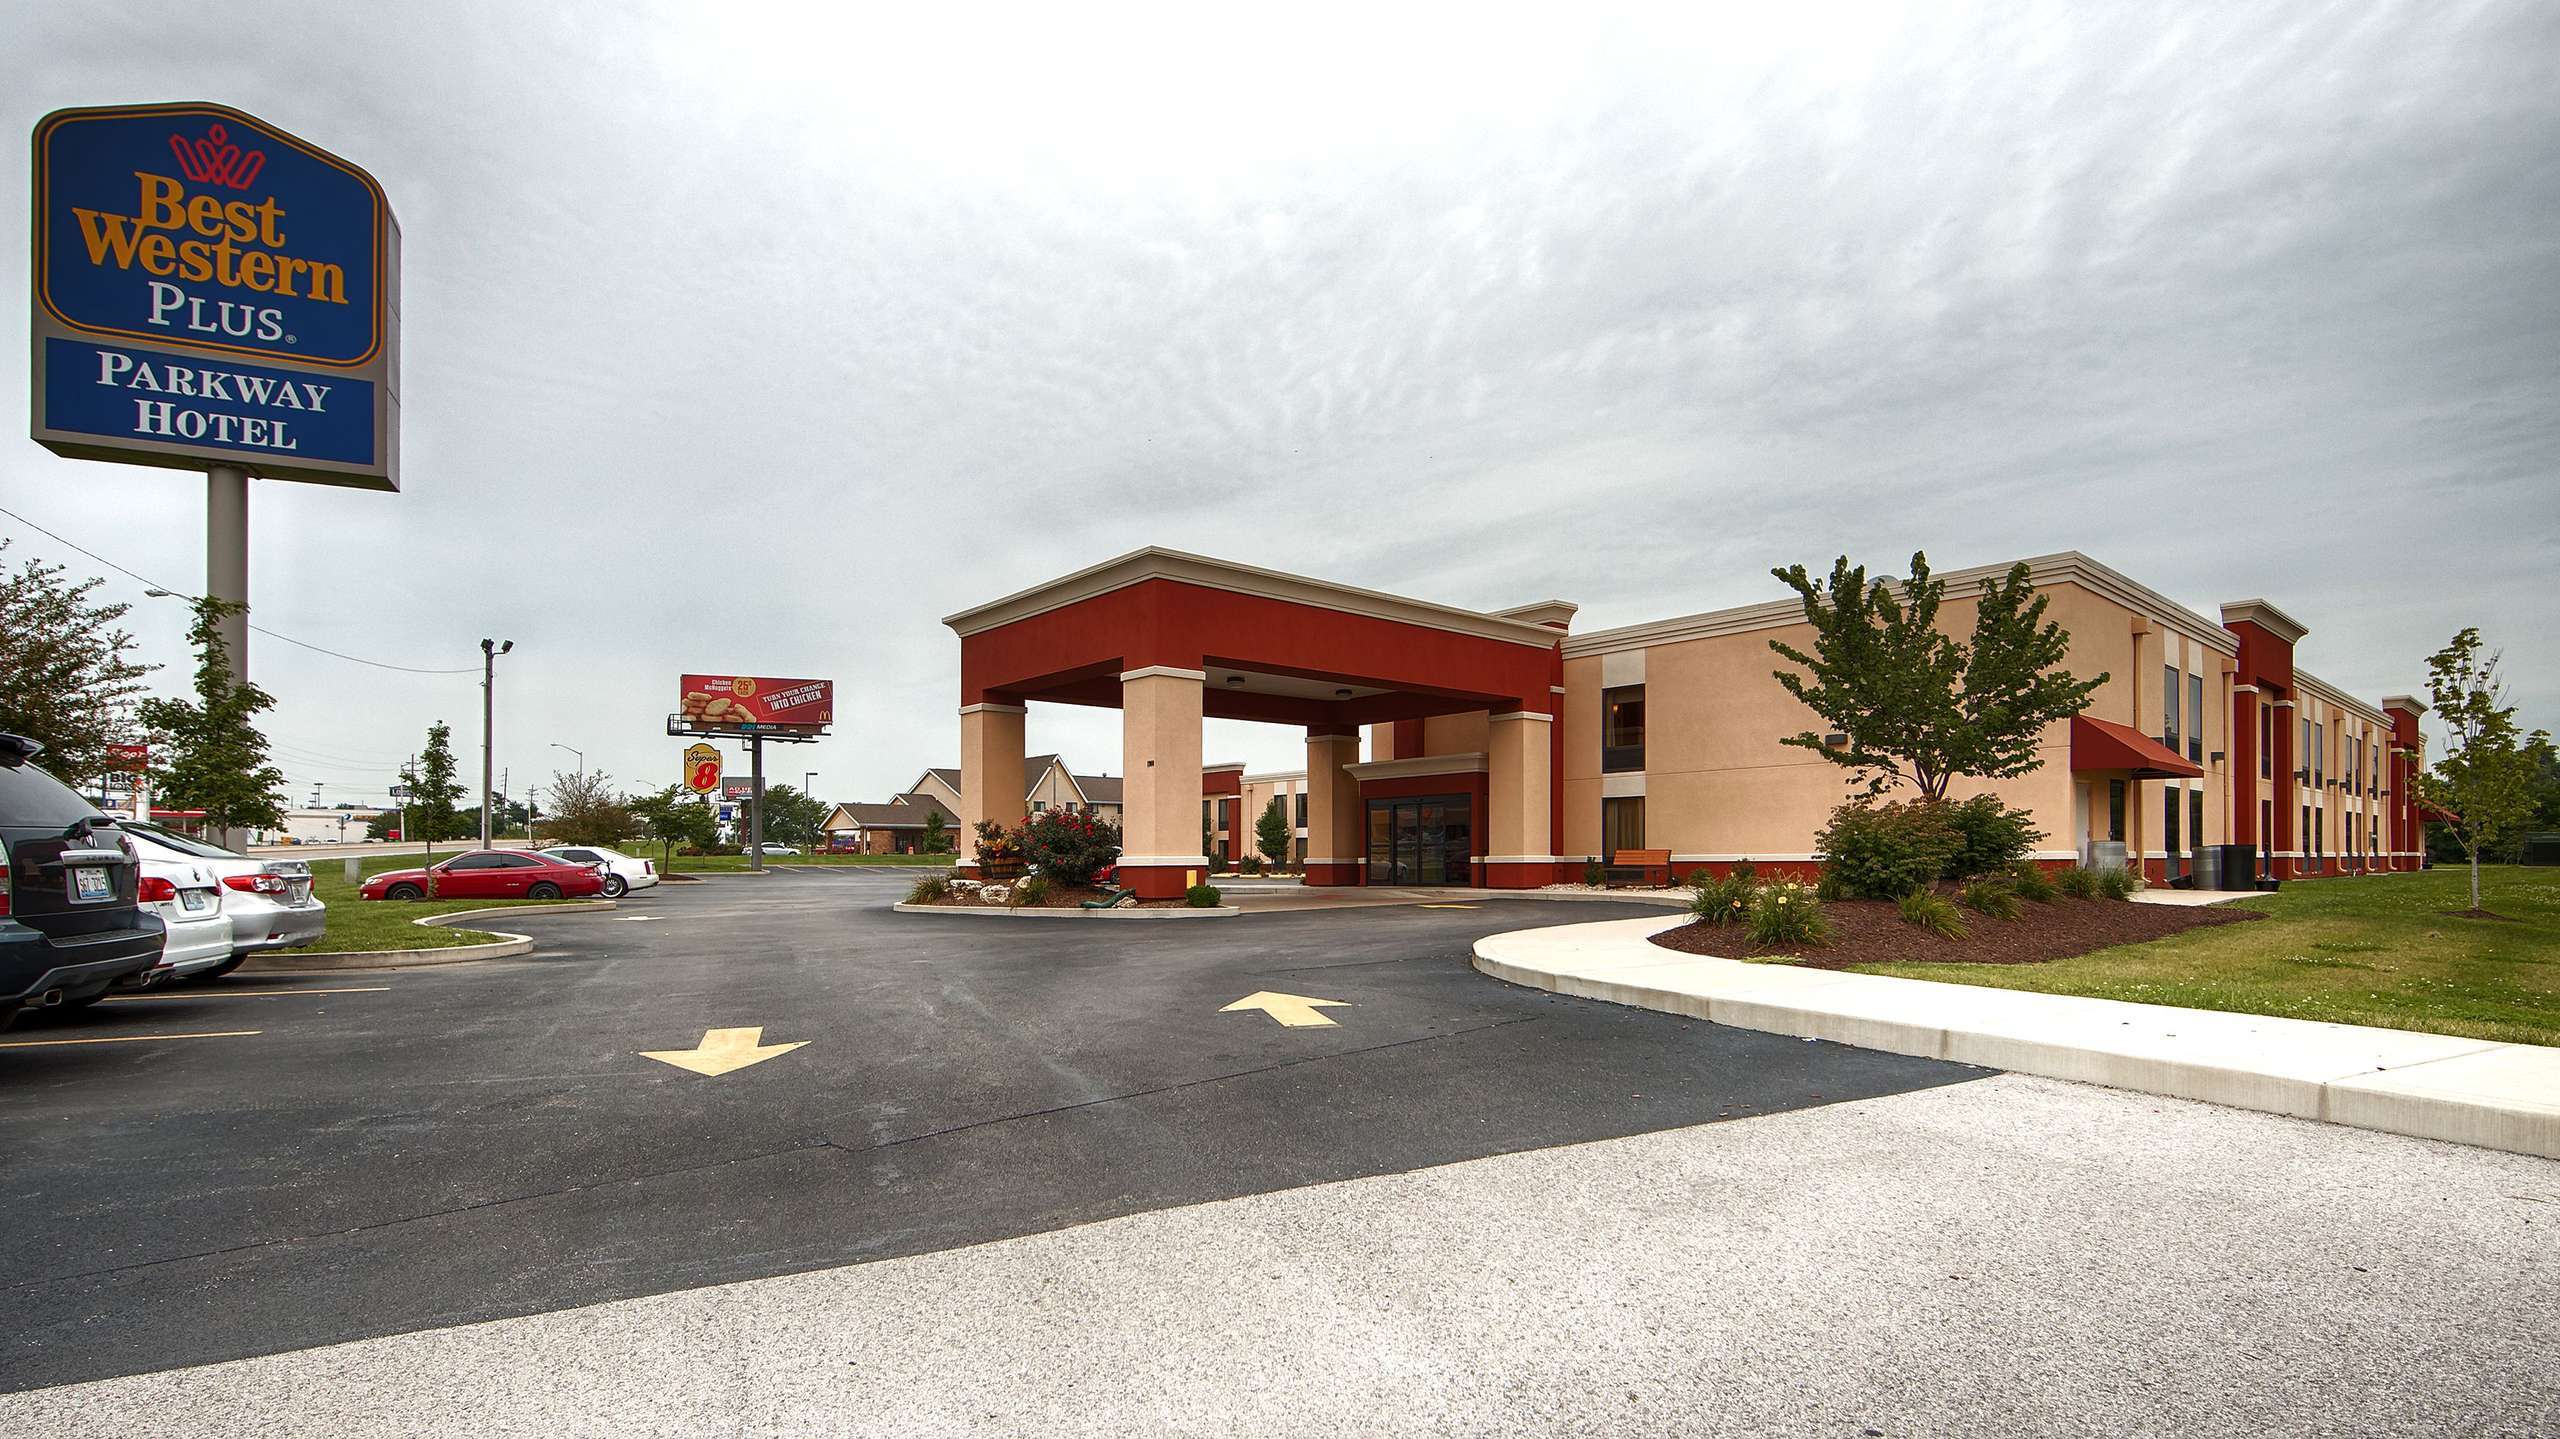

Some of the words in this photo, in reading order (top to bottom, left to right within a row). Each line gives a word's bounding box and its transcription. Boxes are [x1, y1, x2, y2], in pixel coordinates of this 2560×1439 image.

[134, 171, 286, 247] Best
[72, 207, 348, 305] Western
[95, 351, 333, 412] PARKWAY
[133, 399, 297, 450] HOTEL
[762, 693, 781, 703] TURN
[781, 689, 800, 698] YOUR
[800, 682, 826, 694] CHANGE
[770, 697, 790, 711] INTO
[789, 690, 822, 706] CHICKEN
[687, 751, 719, 767] Super
[692, 763, 718, 789] 8
